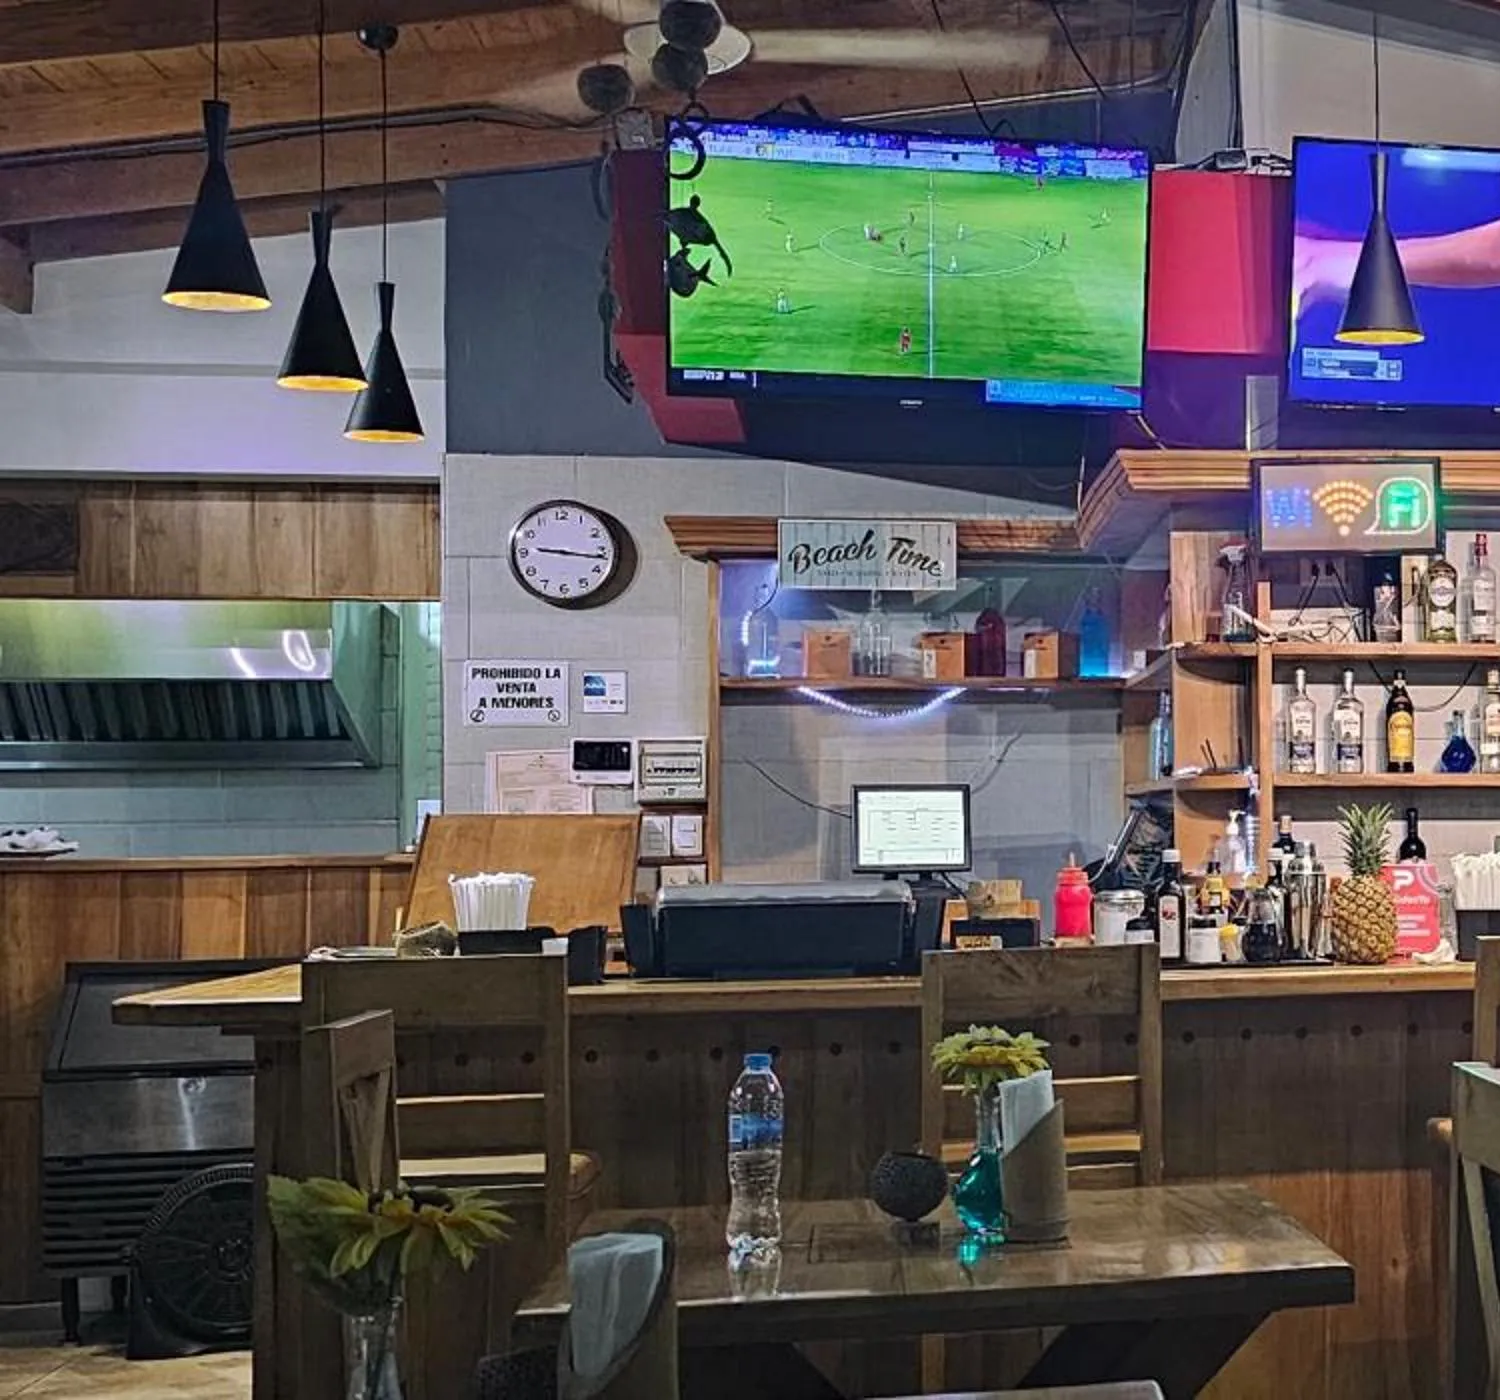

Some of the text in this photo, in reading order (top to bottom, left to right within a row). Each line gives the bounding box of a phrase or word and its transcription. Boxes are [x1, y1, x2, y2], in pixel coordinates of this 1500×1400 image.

[555, 510, 569, 521] 12
[788, 528, 945, 577] Beach Time
[472, 667, 561, 679] PROHIBIDO LA
[496, 682, 536, 693] VENTA
[478, 696, 554, 709] A MENORES
